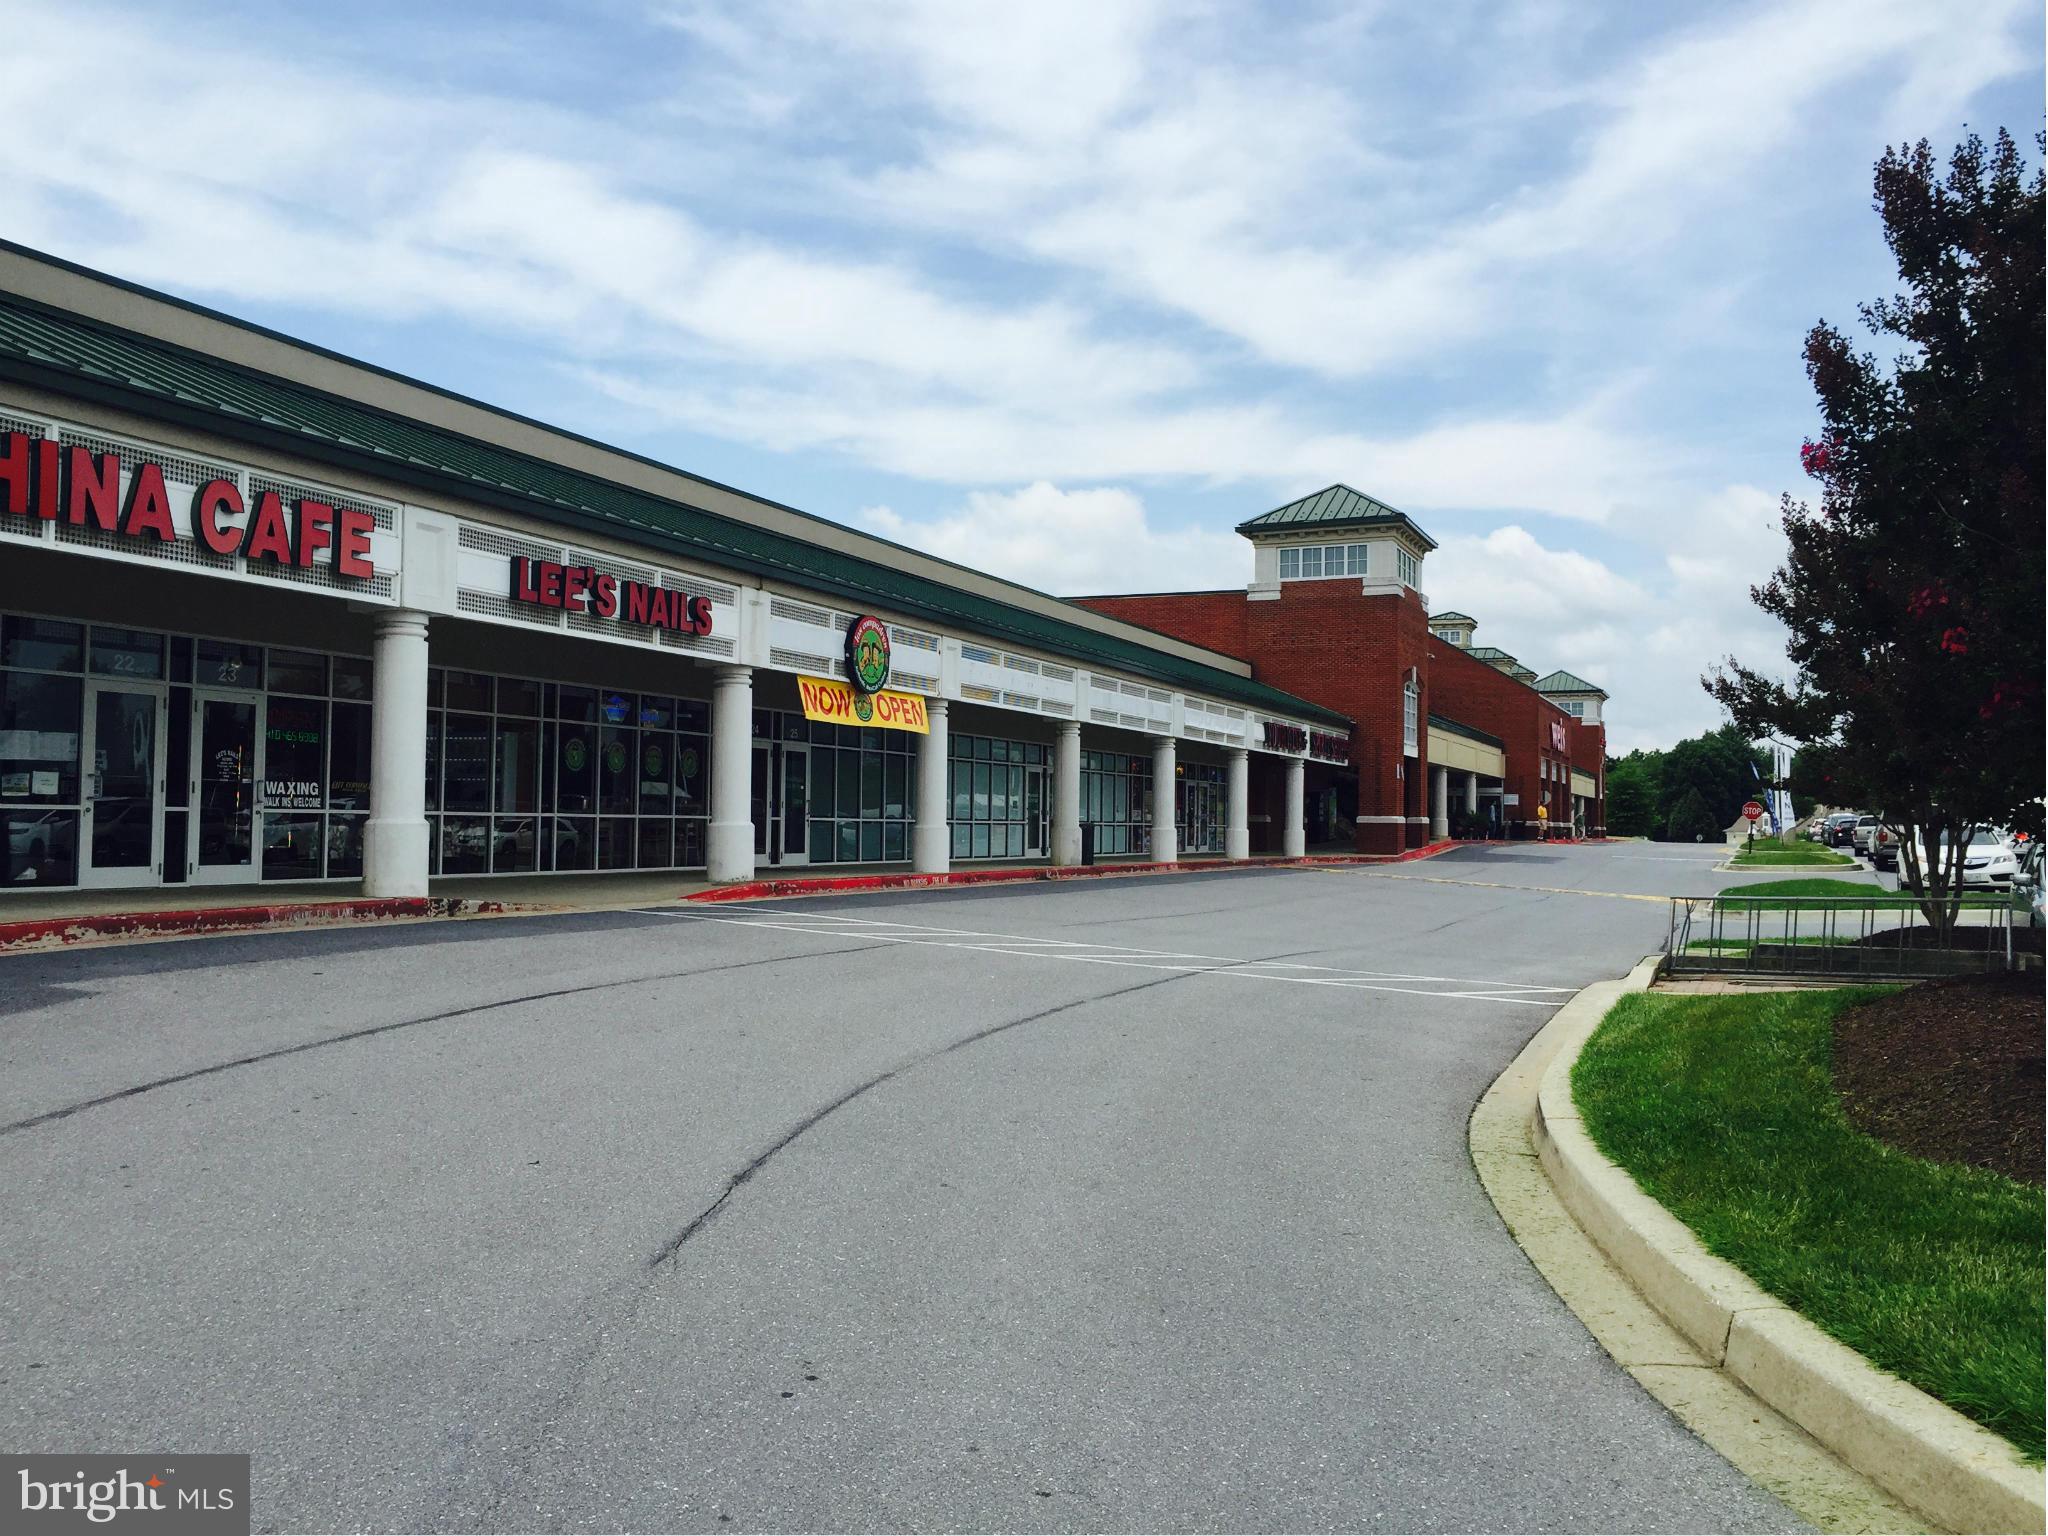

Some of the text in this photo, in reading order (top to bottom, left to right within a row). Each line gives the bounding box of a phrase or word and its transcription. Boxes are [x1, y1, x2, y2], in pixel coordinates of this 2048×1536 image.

[193, 479, 375, 580] CAFE
[514, 555, 713, 637] LEE'S NAILS
[114, 654, 135, 671] 22
[219, 665, 237, 682] 23
[802, 682, 924, 727] NOW OPEN
[265, 781, 320, 796] WAXING
[293, 797, 321, 808] WELCOME
[1743, 807, 1762, 817] STOP
